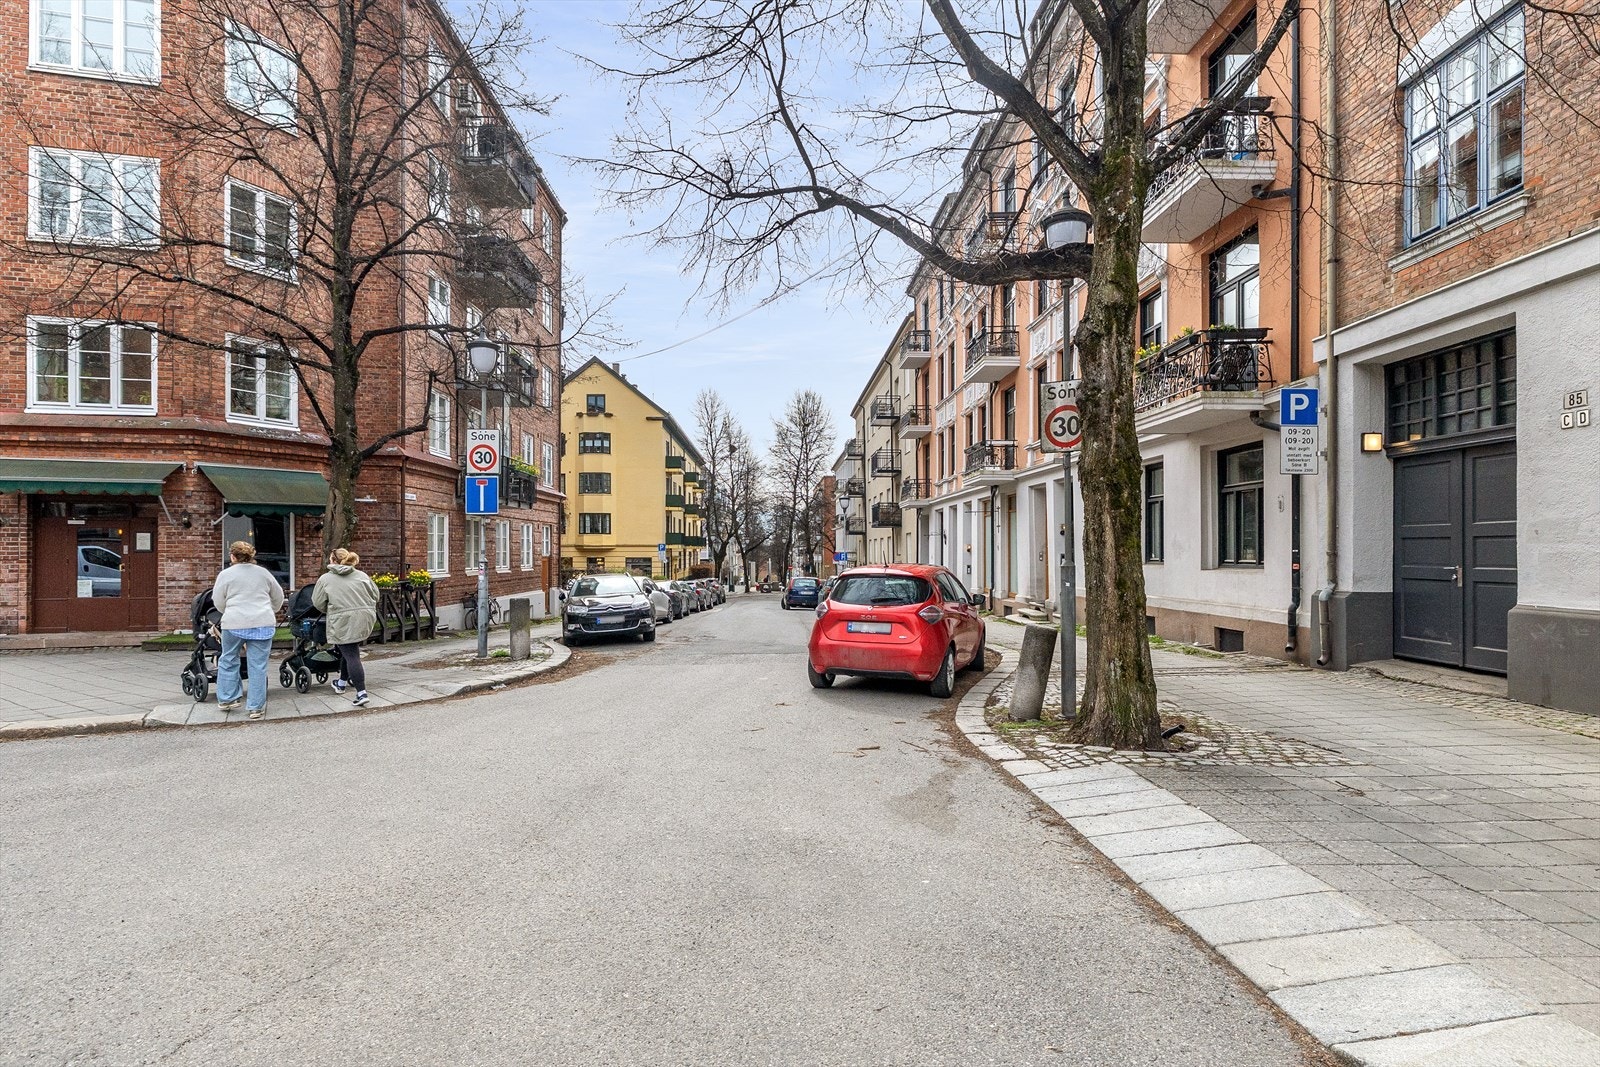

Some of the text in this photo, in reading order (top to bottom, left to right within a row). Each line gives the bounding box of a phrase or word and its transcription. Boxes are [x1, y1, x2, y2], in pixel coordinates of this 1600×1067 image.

[1048, 387, 1076, 400] Son
[1568, 393, 1582, 406] 85
[1290, 393, 1309, 421] P
[1564, 412, 1586, 426] C D
[1053, 416, 1080, 437] 30
[471, 432, 496, 440] Sone
[474, 451, 492, 464] 30
